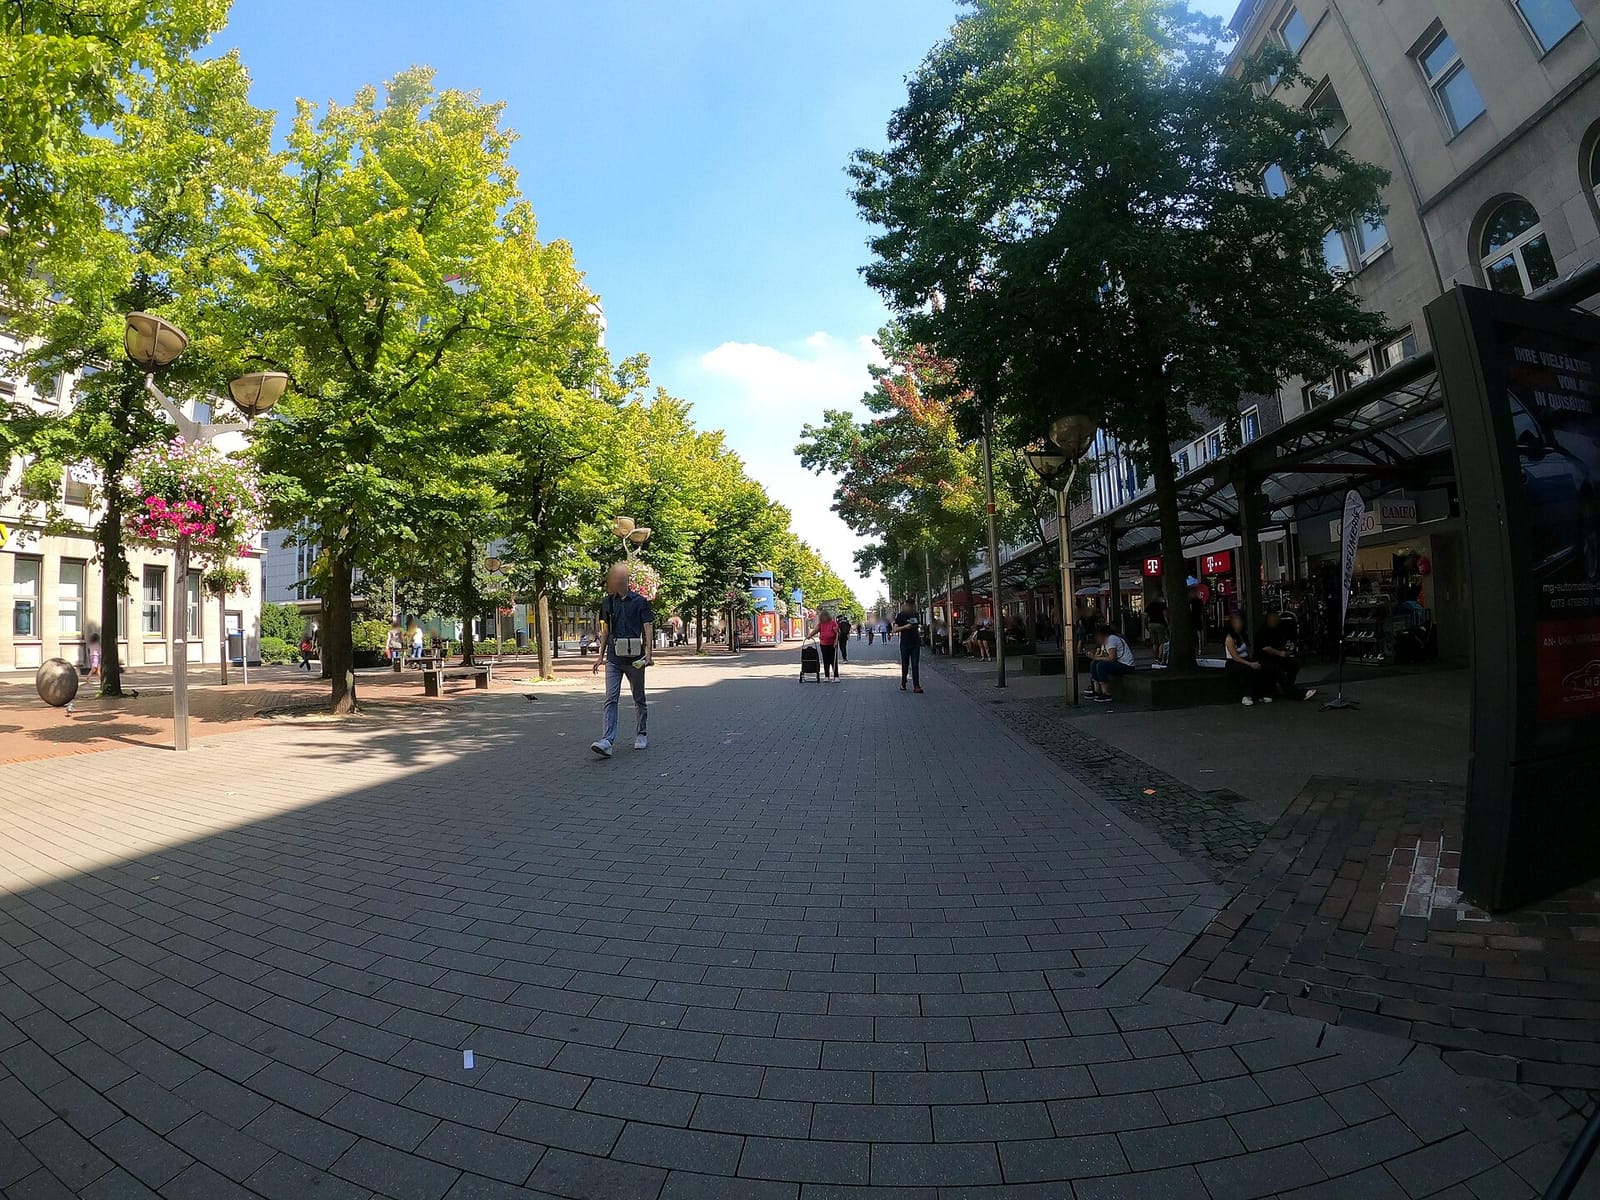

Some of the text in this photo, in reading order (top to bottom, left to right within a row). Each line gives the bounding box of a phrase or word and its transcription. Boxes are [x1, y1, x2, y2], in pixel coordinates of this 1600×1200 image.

[1534, 391, 1547, 407] IN
[1382, 505, 1415, 519] CAMEO
[1147, 559, 1159, 573] T
